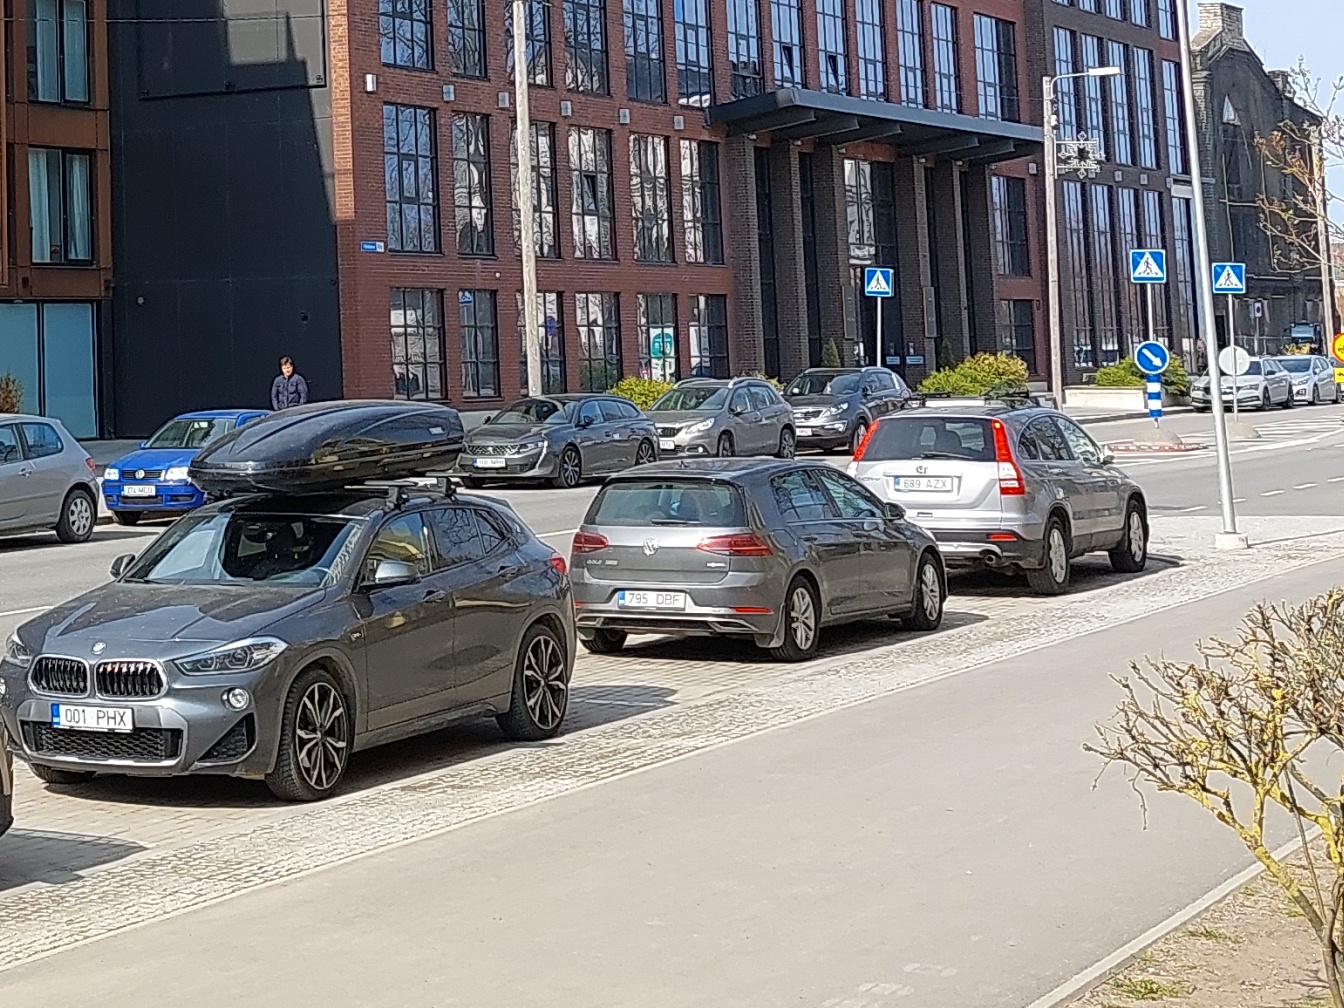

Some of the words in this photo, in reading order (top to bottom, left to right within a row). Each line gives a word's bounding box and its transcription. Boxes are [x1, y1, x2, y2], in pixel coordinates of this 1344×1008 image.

[926, 479, 947, 488] AZX
[628, 592, 648, 604] 795
[656, 593, 681, 605] DBF
[65, 708, 86, 725] 001
[96, 709, 126, 726] PHX
